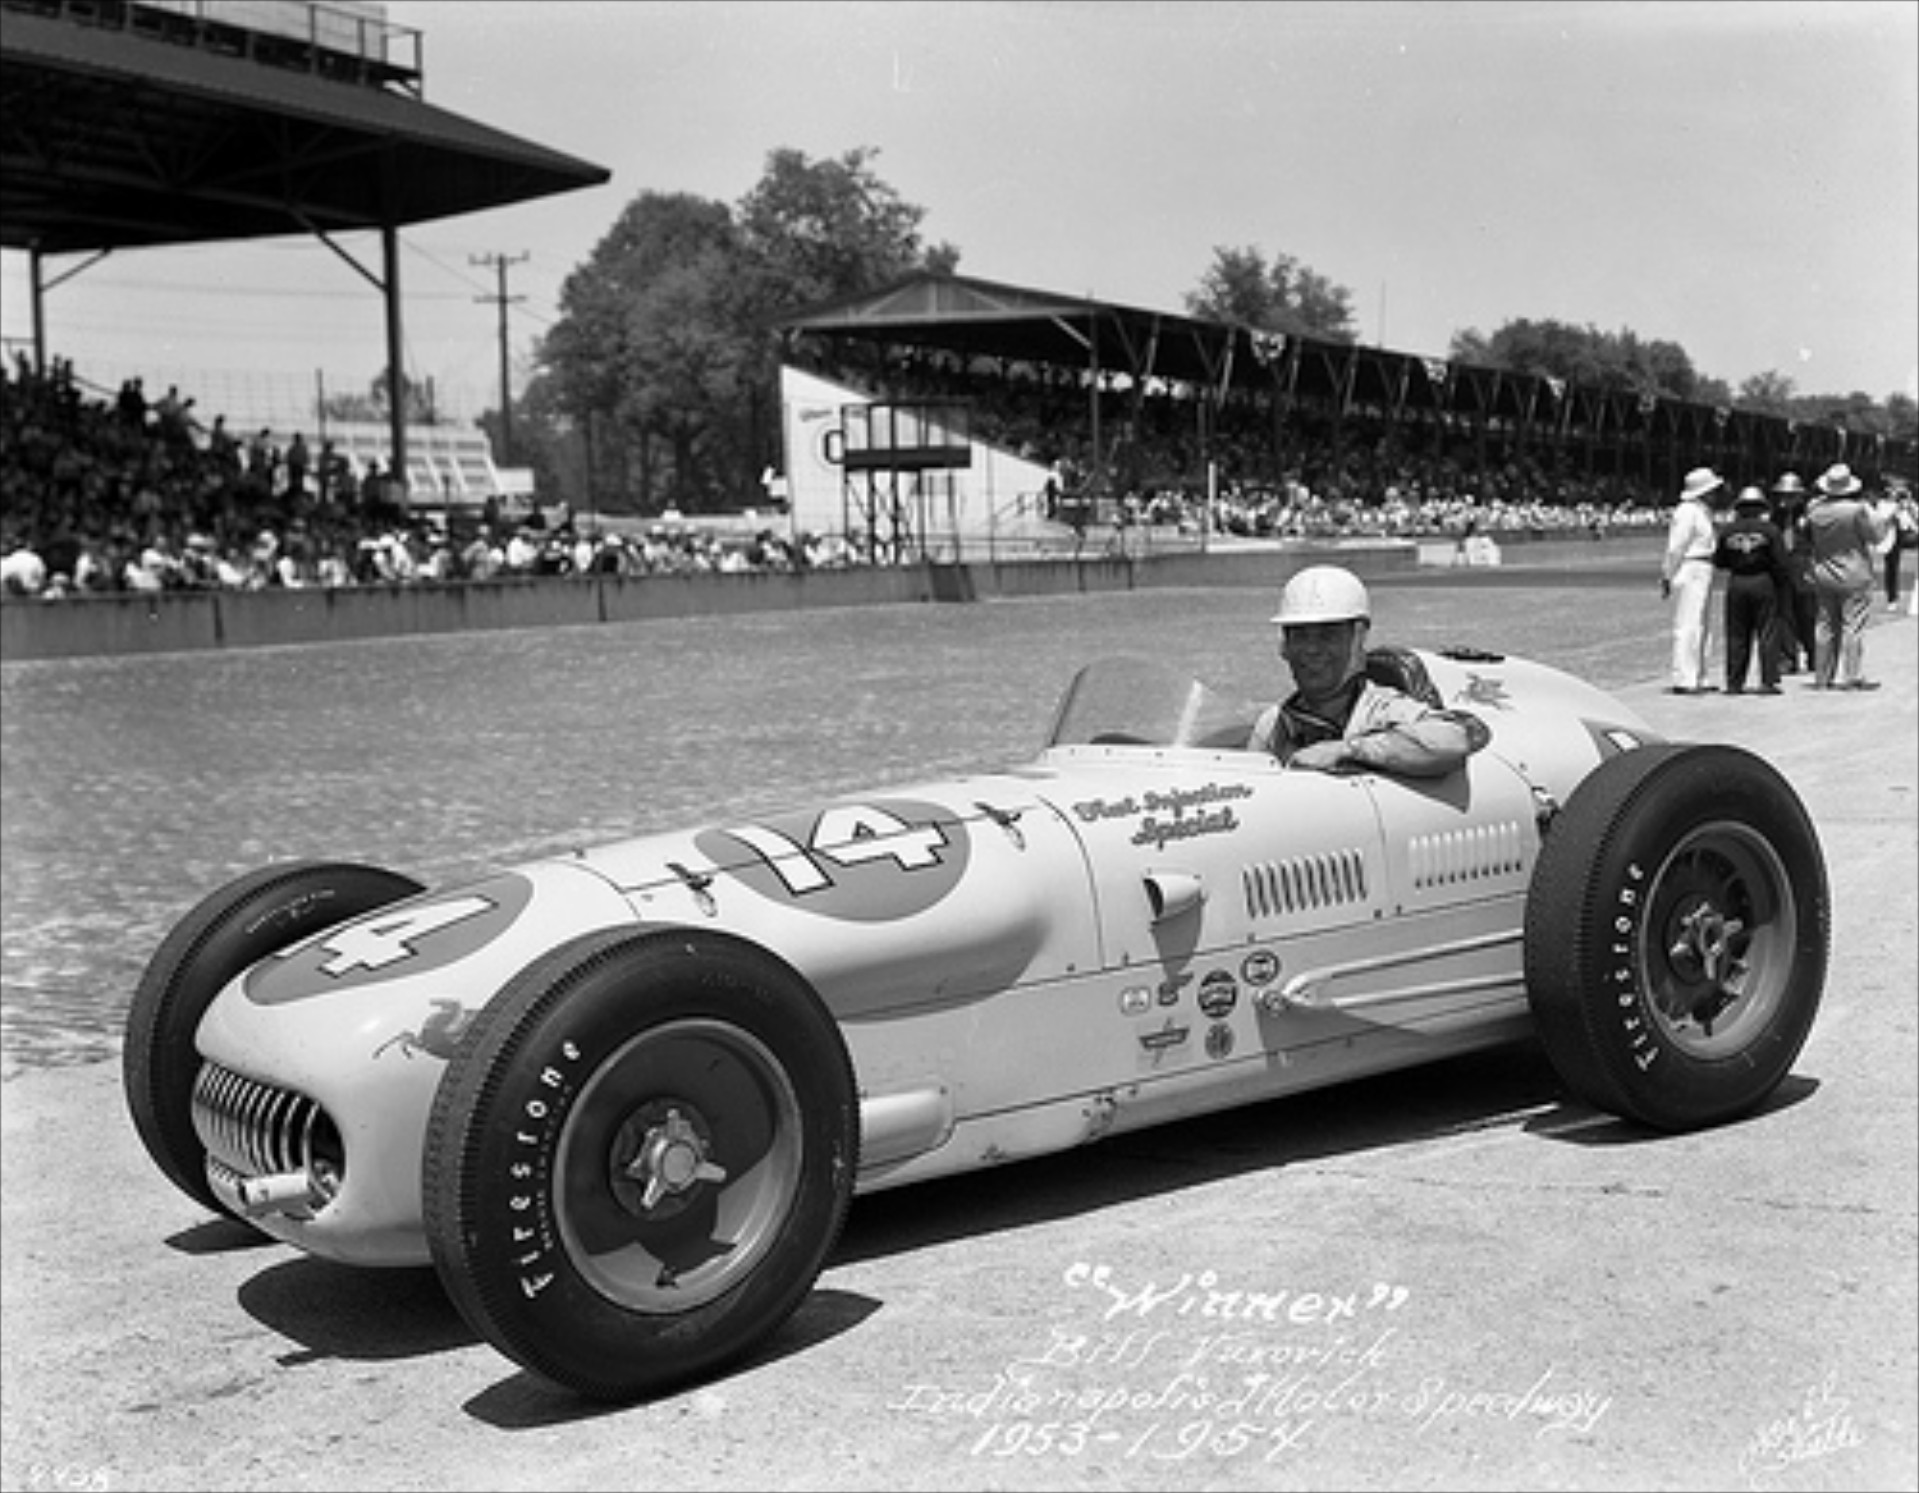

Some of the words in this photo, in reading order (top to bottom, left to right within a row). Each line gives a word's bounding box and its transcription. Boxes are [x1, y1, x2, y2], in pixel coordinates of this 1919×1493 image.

[722, 803, 950, 897] 14
[1131, 806, 1240, 851] Special
[1613, 862, 1659, 1071] Firestone
[509, 1039, 581, 1299] Firestone
